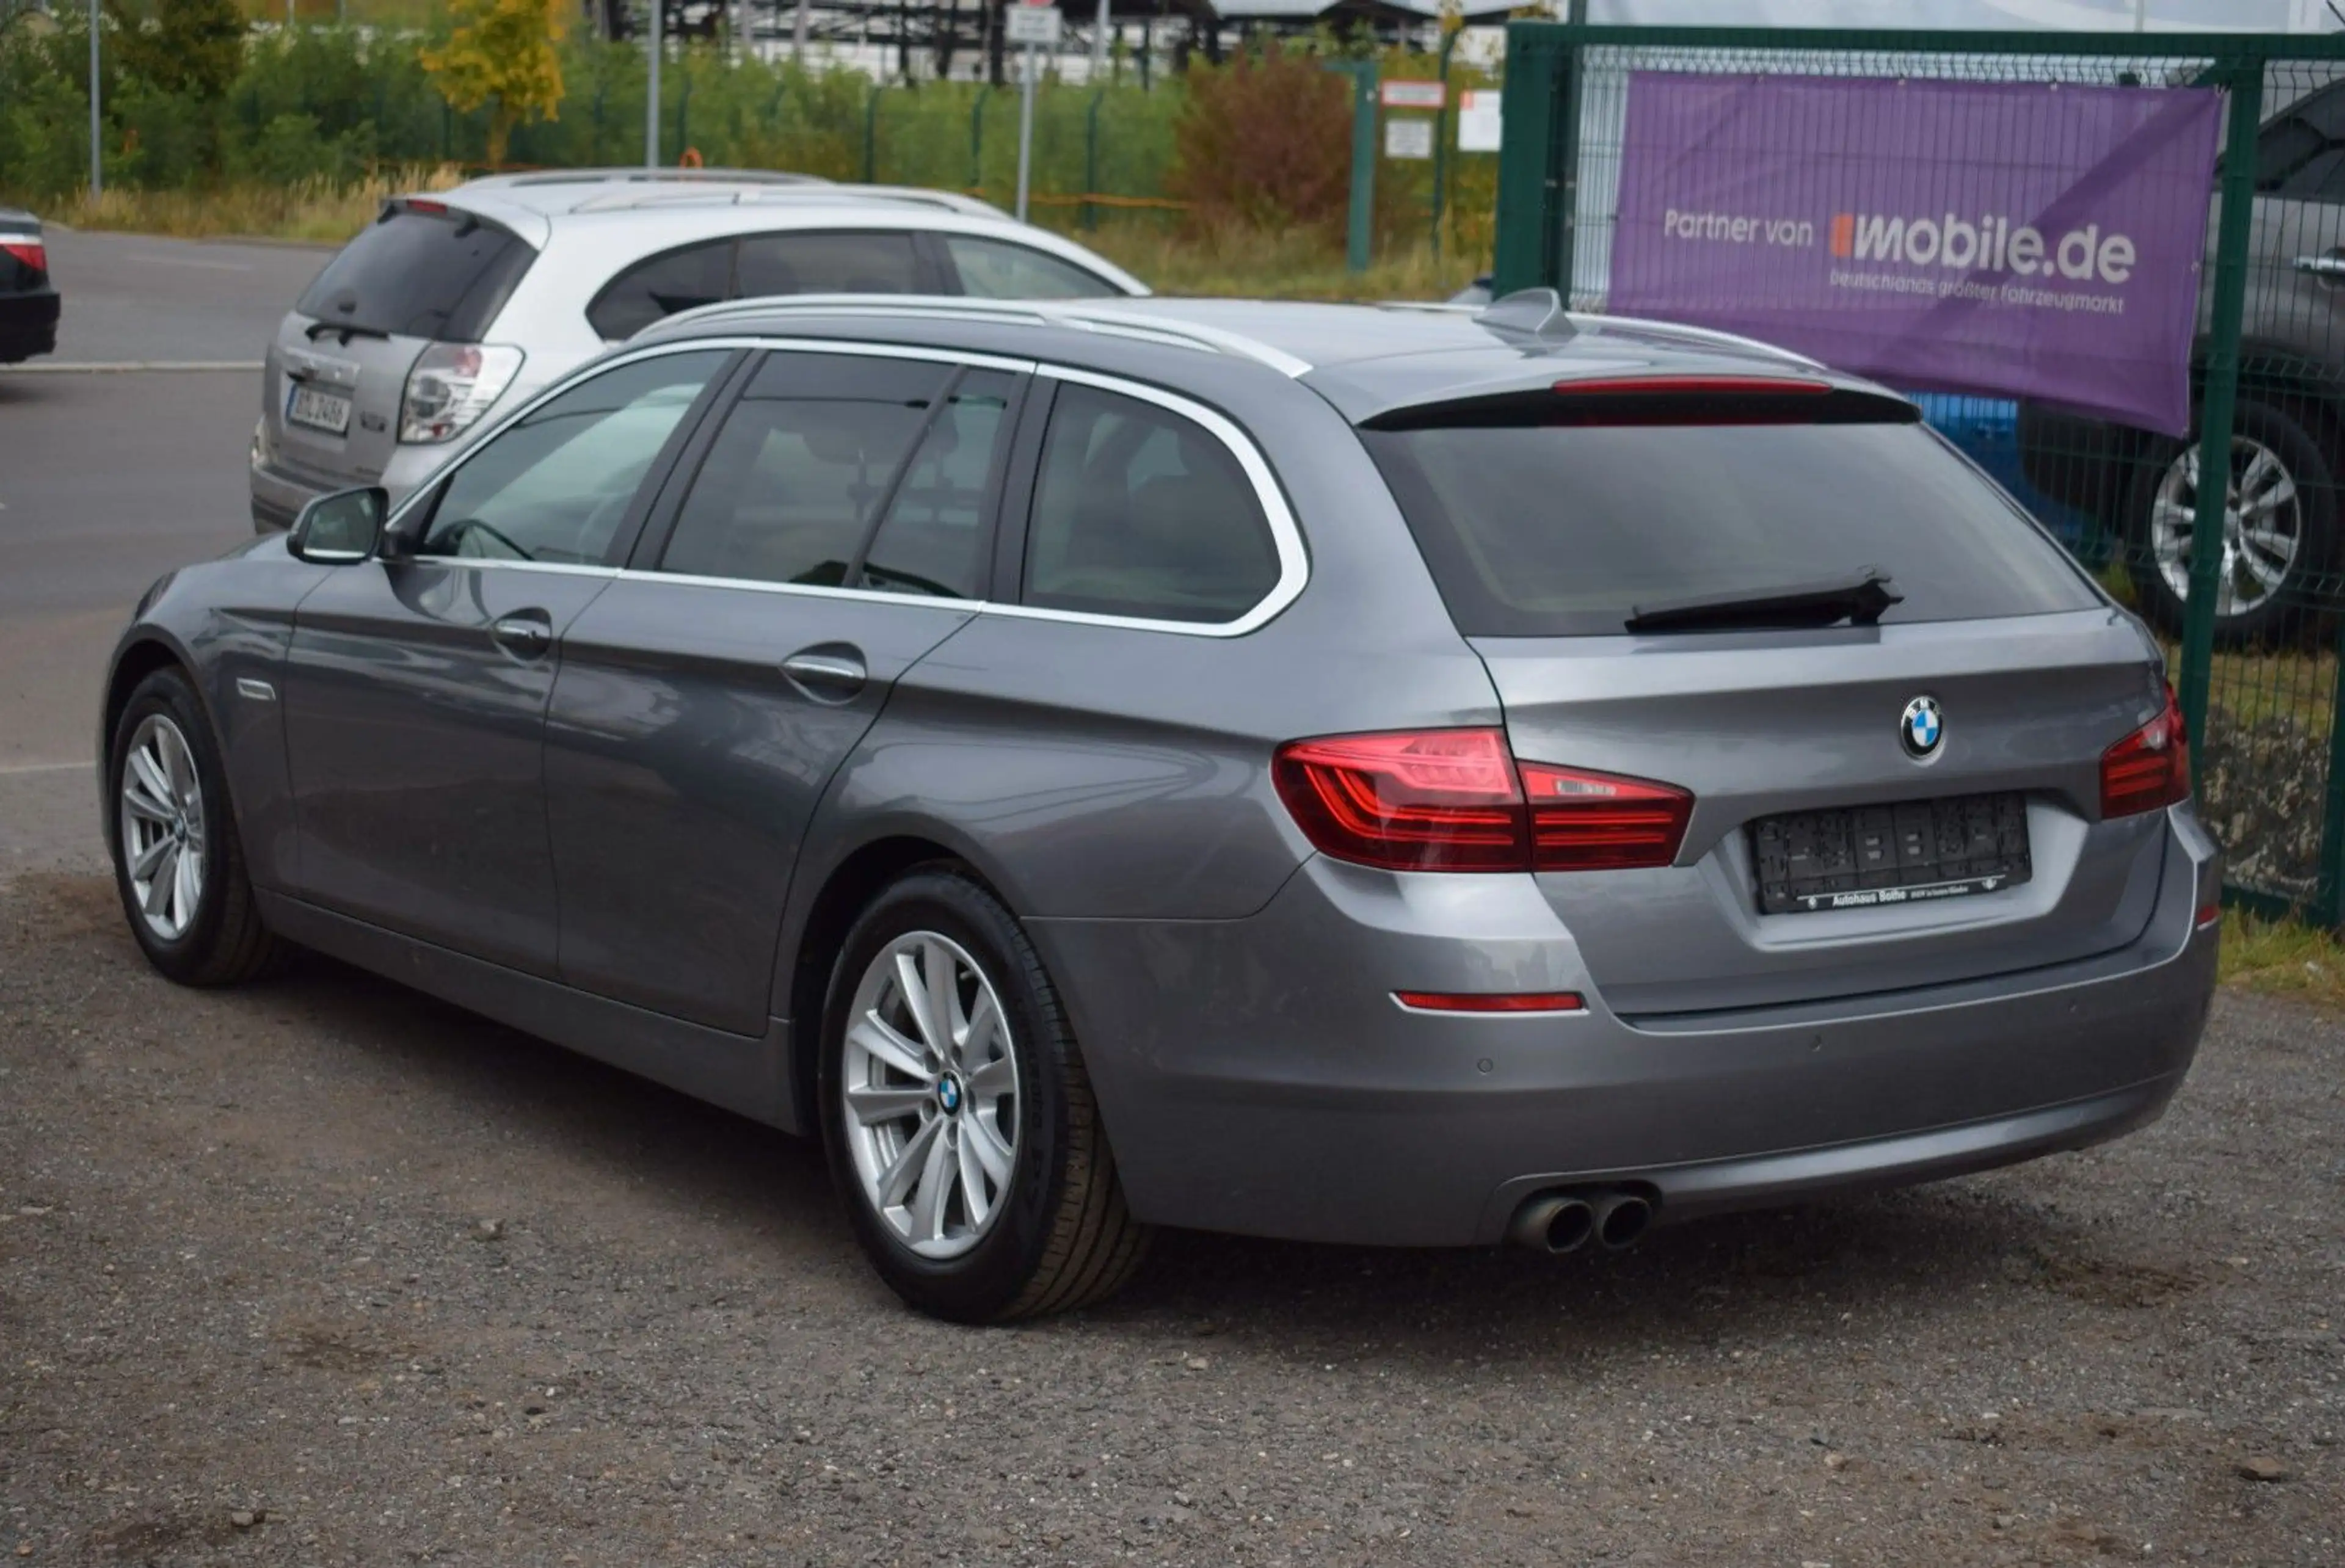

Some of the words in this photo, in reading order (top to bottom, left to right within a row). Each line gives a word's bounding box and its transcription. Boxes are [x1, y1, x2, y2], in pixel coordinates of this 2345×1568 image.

[1664, 208, 1761, 242] Partner
[1765, 219, 1813, 247] von
[1830, 268, 1935, 296] Deutschlands
[1832, 892, 1877, 907] Autohaus
